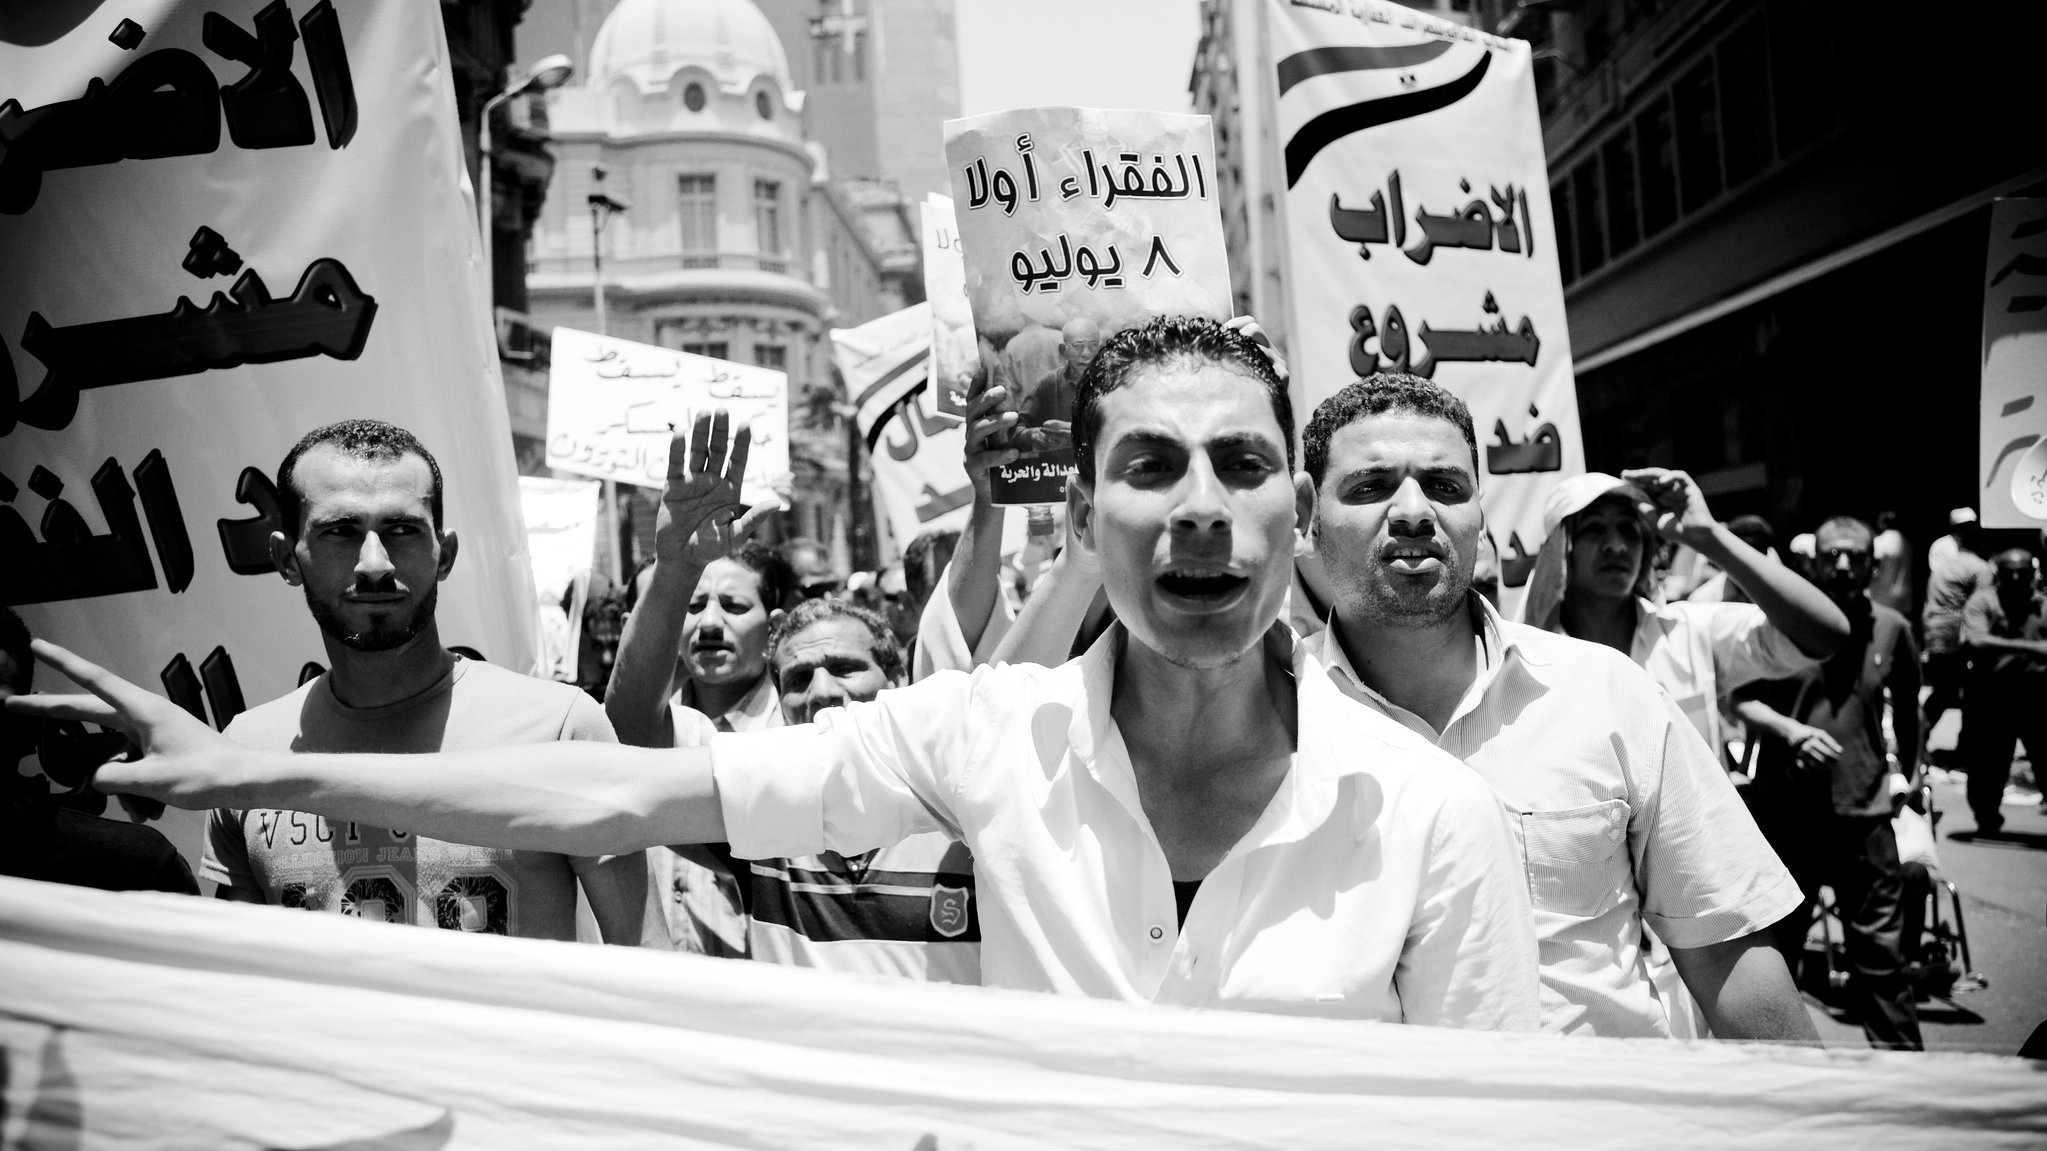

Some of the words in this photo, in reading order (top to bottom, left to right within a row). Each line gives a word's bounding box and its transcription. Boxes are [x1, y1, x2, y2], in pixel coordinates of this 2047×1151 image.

[0, 0, 358, 215] الاضر
[964, 133, 1039, 215] أولا
[1060, 150, 1206, 209] الفقراء
[1330, 170, 1534, 266] الاضراب
[1011, 233, 1124, 293] يوليو
[0, 225, 378, 432] مشر
[1349, 289, 1541, 380] مشروع
[1041, 462, 1080, 478] لعدالة
[1486, 403, 1562, 475] ضد
